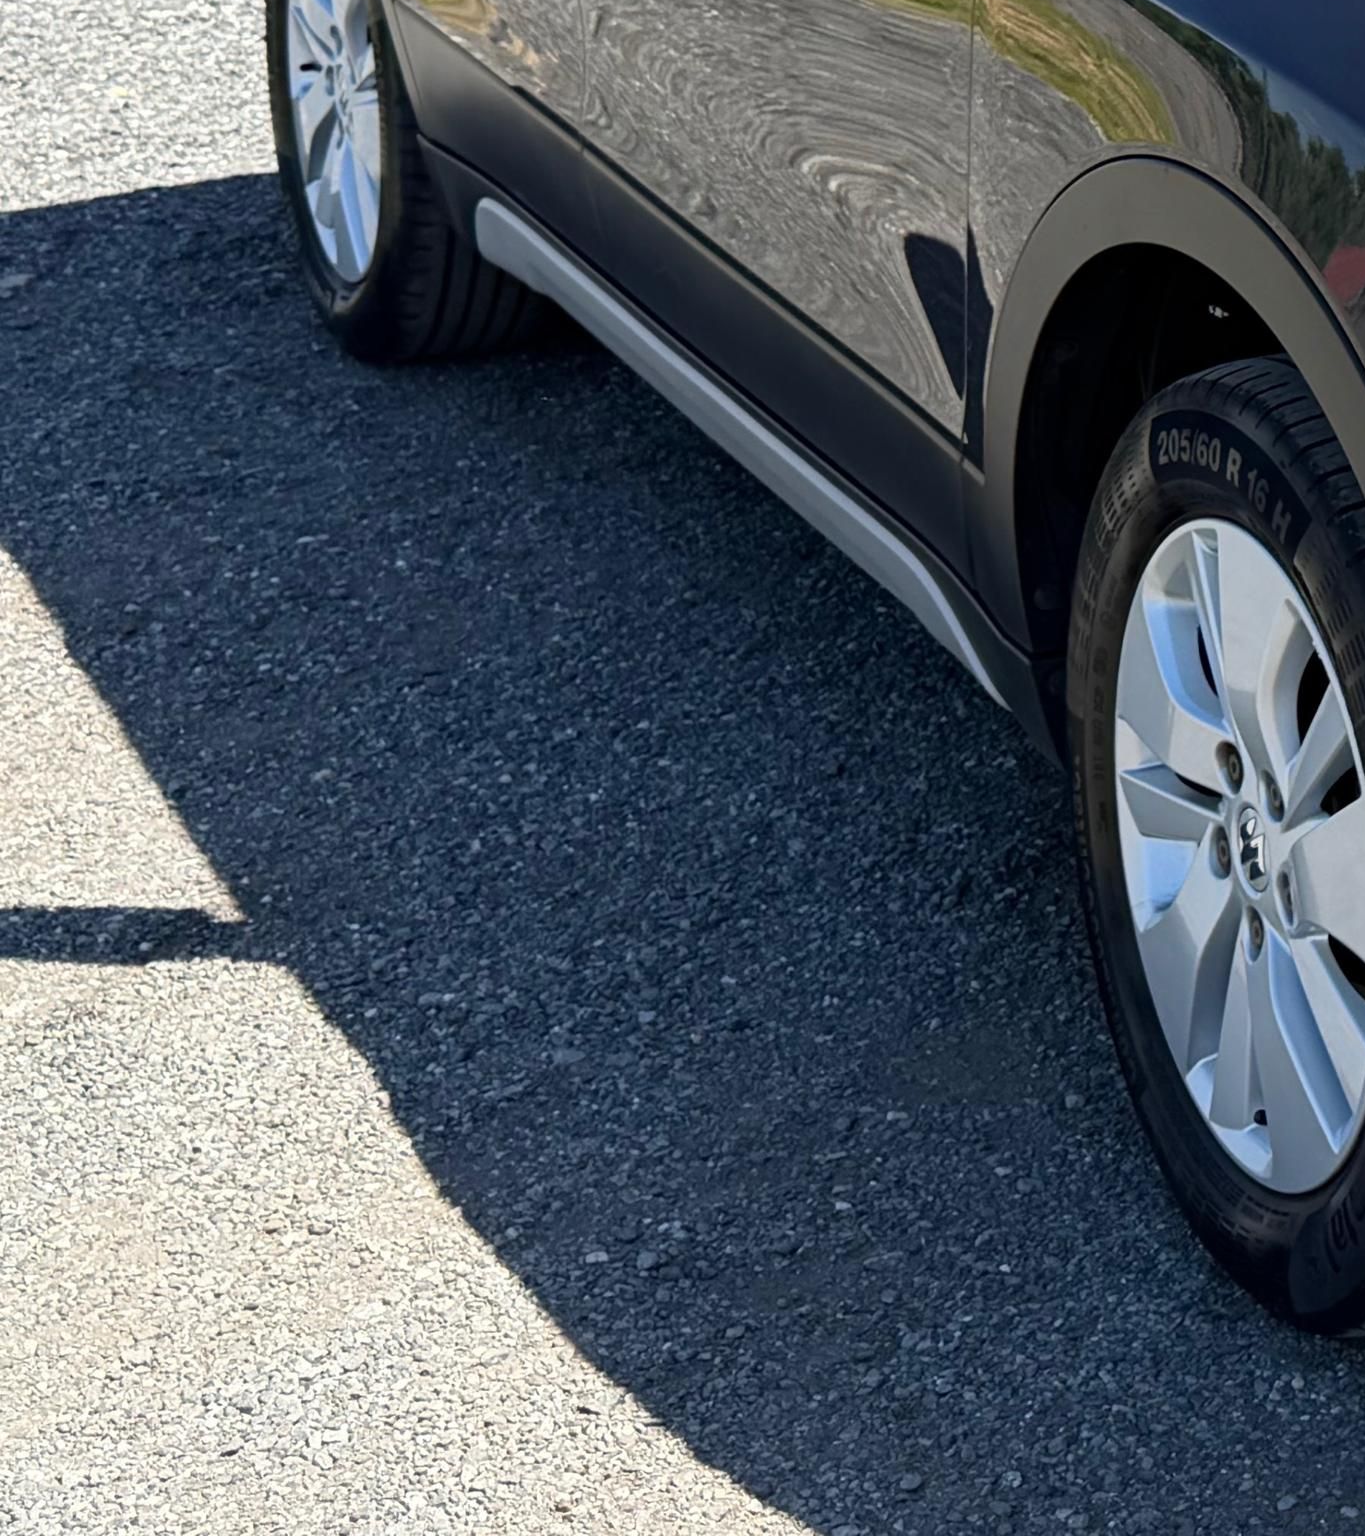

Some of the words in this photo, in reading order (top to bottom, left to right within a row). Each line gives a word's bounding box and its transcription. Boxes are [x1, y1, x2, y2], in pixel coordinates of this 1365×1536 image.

[1156, 427, 1222, 473] 205/60
[1225, 447, 1243, 489] R
[1247, 468, 1271, 514] 16
[1270, 498, 1293, 546] H
